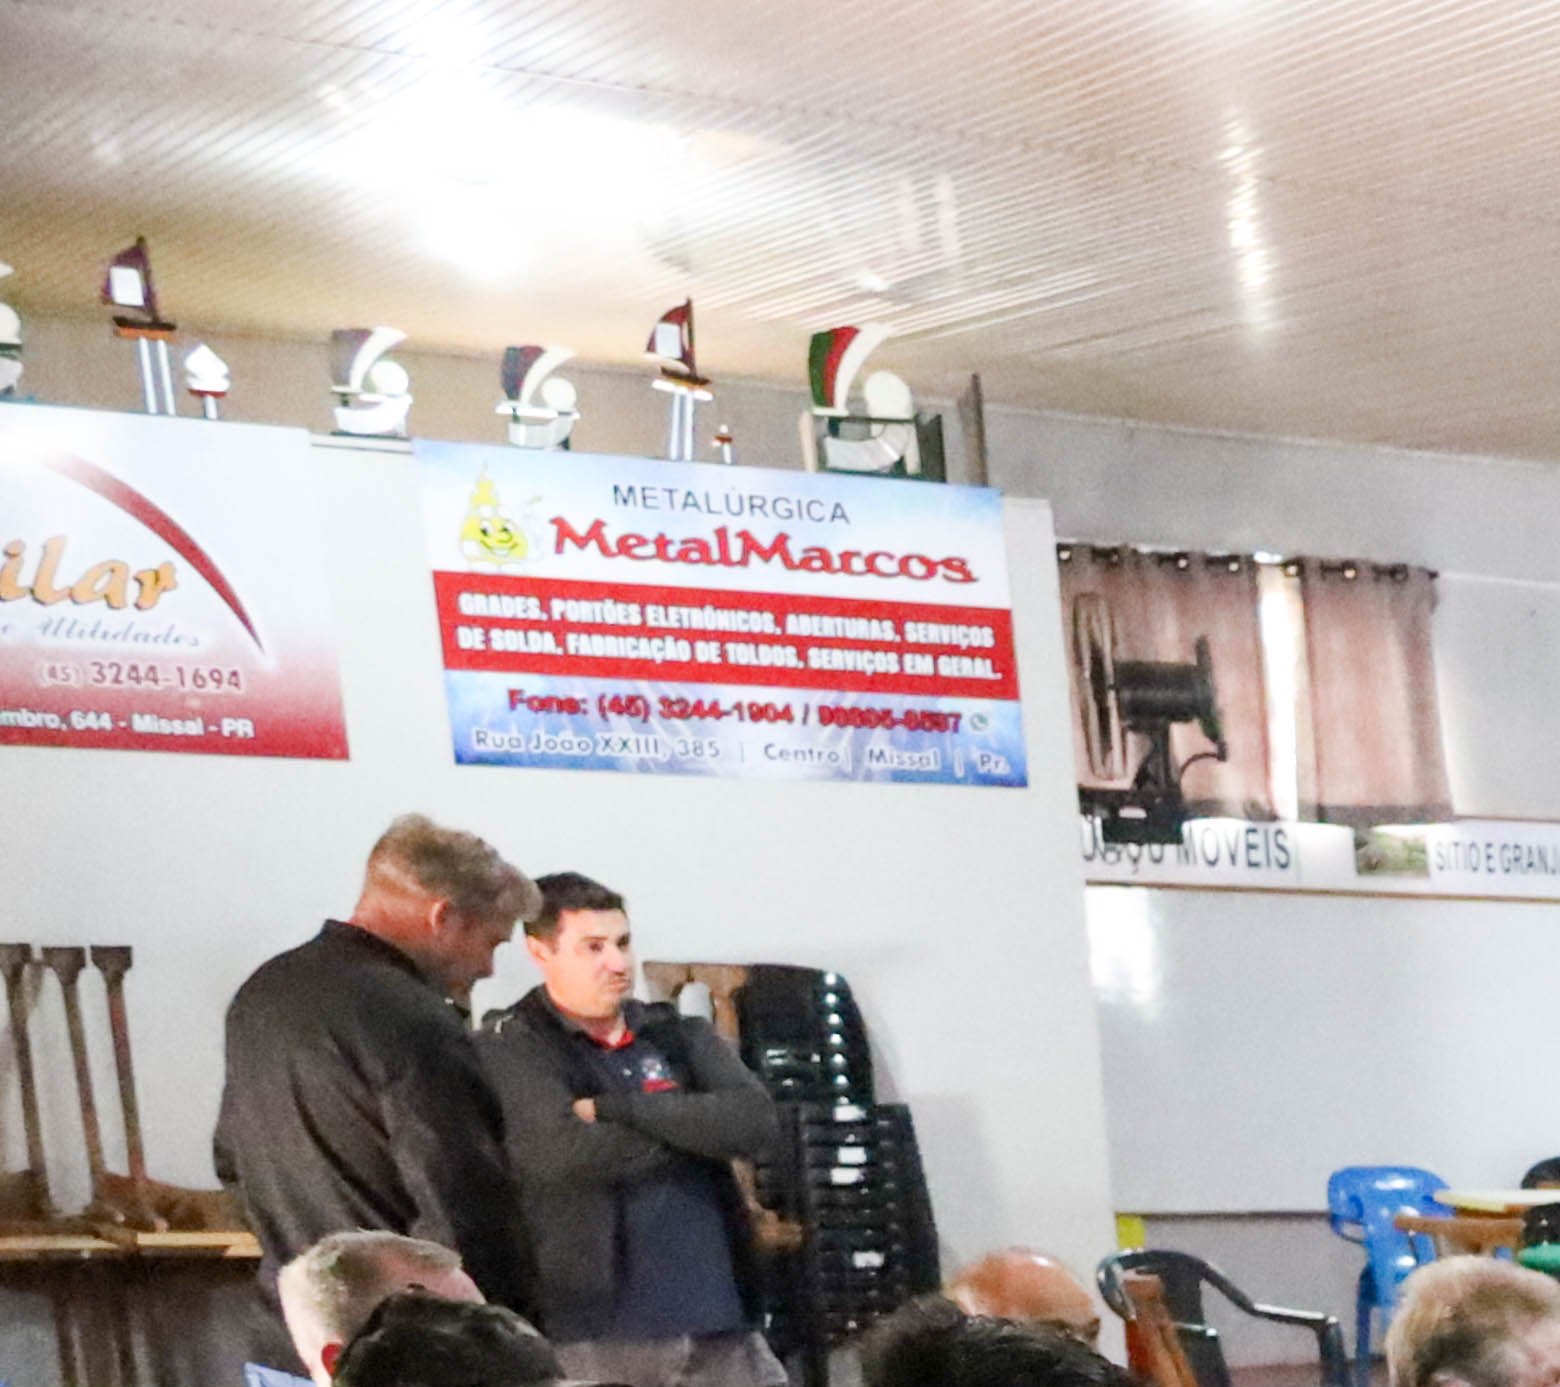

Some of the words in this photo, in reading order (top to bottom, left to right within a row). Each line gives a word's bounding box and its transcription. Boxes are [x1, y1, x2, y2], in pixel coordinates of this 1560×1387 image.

[613, 484, 850, 525] METALÚRGICA
[548, 516, 979, 584] MetalMarcos
[457, 591, 548, 621] GRADES,
[551, 598, 642, 626] PORTÕES
[645, 603, 782, 635] ELETRÔNICOS,
[785, 612, 902, 643] ABERTURAS,
[903, 620, 995, 649] SERVIÇOS
[456, 626, 486, 650] DE
[488, 628, 563, 655] SOLDA,
[566, 632, 692, 663] FABRICAÇÃO
[694, 640, 723, 663] DE
[724, 642, 805, 669] TOLDOS,
[807, 646, 899, 675] SERVIÇOS
[902, 652, 934, 676] EM
[936, 655, 1003, 680] GERAL.
[40, 662, 84, 688] (45)
[91, 661, 242, 691] 3244-1694
[507, 688, 589, 715] Fone:
[70, 710, 113, 731] 644
[131, 712, 205, 737] Missal
[221, 717, 256, 739] PR
[474, 728, 523, 750] Rua
[678, 739, 721, 759] 385
[763, 743, 841, 763] Centro
[868, 748, 939, 768] Missal
[1485, 843, 1496, 873] E
